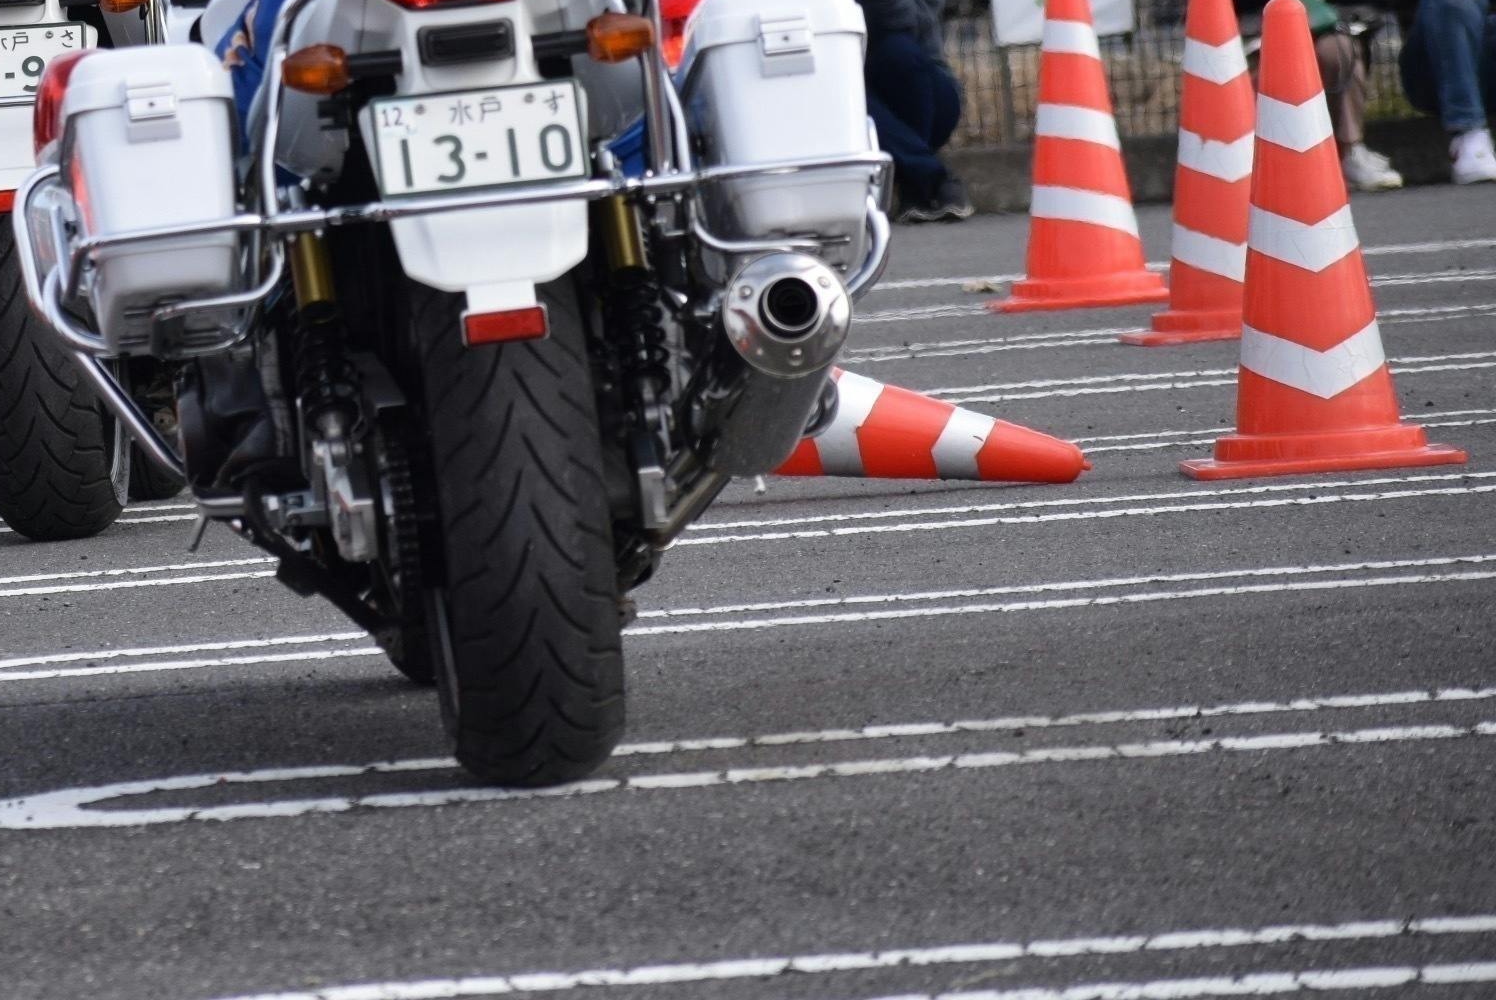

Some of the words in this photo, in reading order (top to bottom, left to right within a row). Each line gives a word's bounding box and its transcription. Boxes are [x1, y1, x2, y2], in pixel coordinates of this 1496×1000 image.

[60, 29, 74, 48] さ
[449, 96, 503, 126] 水戸
[543, 90, 565, 115] す
[400, 123, 574, 189] 13-10
